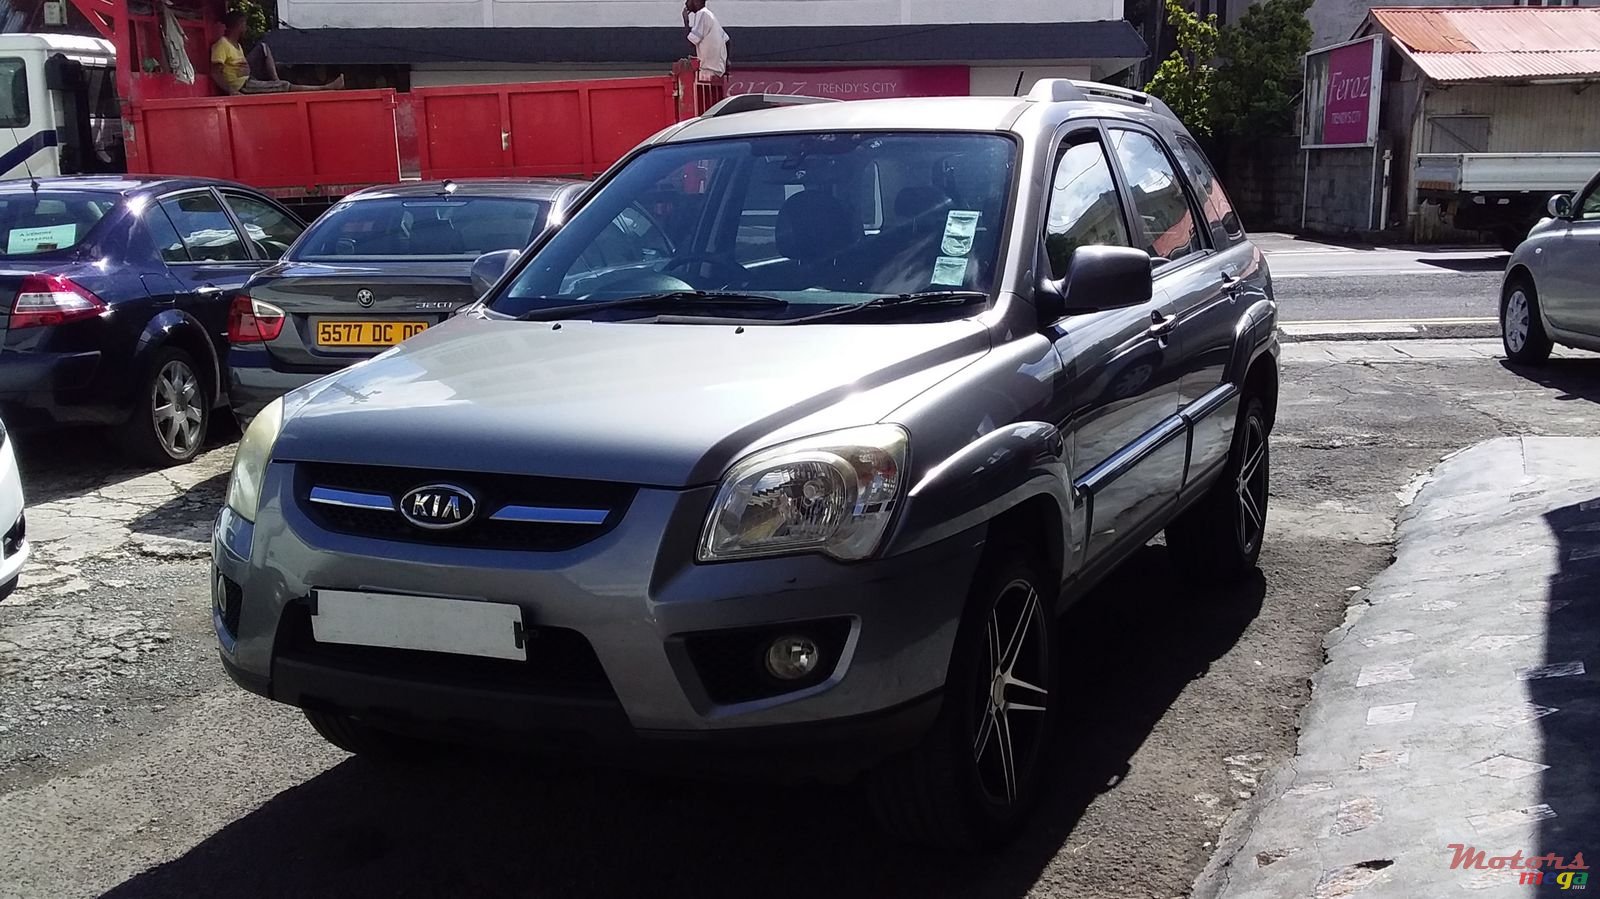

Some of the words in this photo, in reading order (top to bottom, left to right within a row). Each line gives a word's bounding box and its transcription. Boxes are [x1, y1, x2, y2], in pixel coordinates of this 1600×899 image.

[727, 81, 807, 97] eroz
[816, 83, 869, 94] TRENDY'S
[872, 83, 897, 93] CITY
[1328, 71, 1370, 105] Feroz
[320, 324, 363, 342] 5577
[372, 324, 393, 342] DC
[412, 493, 461, 519] KIA
